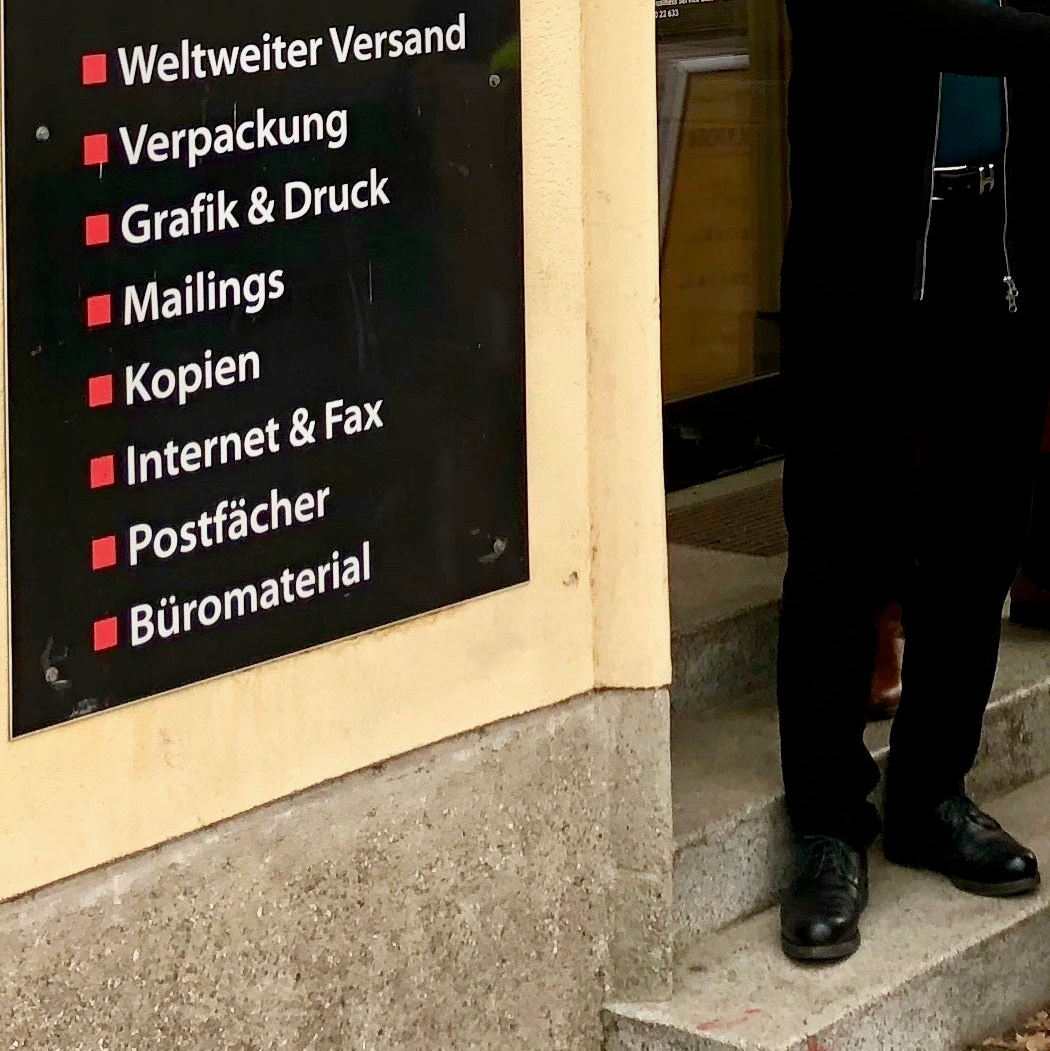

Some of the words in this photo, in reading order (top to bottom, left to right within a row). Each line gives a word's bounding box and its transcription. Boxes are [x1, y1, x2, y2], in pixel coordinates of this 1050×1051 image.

[118, 33, 322, 86] Weltweiter
[328, 12, 466, 63] Versand
[119, 107, 348, 168] Verpackung
[121, 189, 239, 244] Grafik
[247, 186, 275, 225] &
[284, 168, 391, 220] Druck
[123, 264, 285, 326] Mailings
[125, 349, 261, 406] Kopien
[127, 425, 280, 486] Internet
[289, 407, 316, 447] &
[325, 397, 384, 440] Fax
[129, 485, 330, 567] Postfächer
[129, 540, 371, 647] Büromaterial
